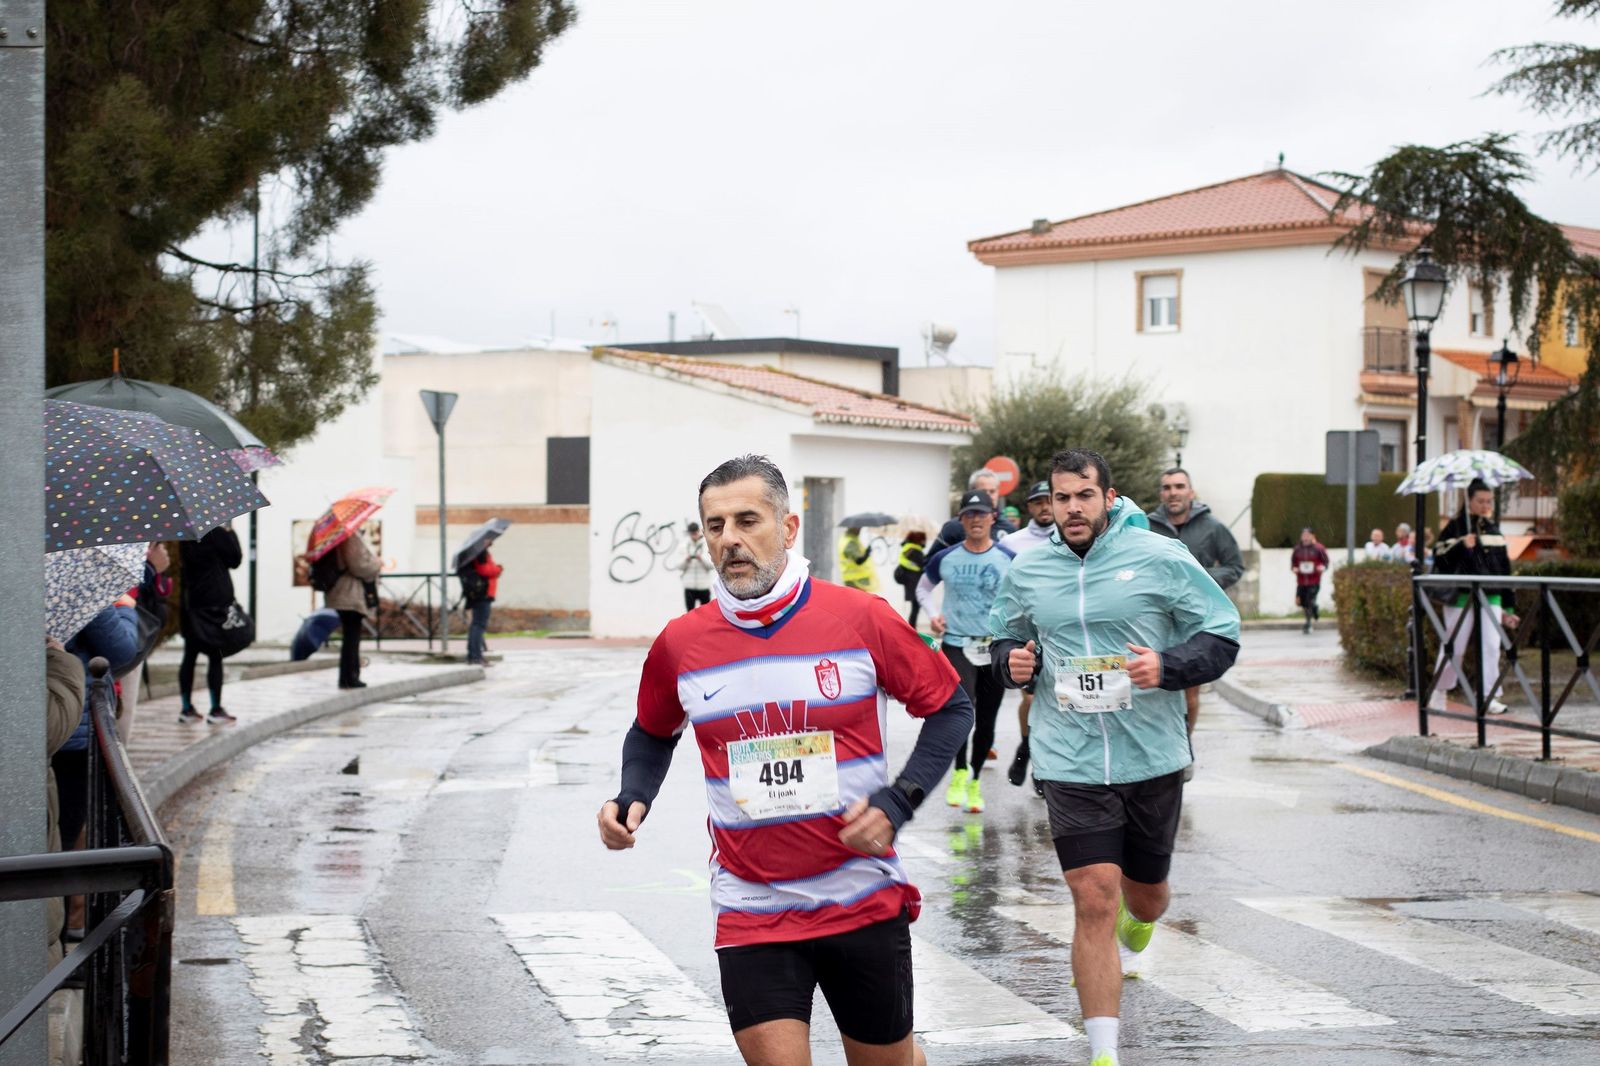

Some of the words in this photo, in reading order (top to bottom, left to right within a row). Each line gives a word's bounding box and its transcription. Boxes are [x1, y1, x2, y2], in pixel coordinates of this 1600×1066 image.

[1077, 673, 1103, 691] 151
[759, 759, 804, 786] 494
[768, 790, 776, 799] El
